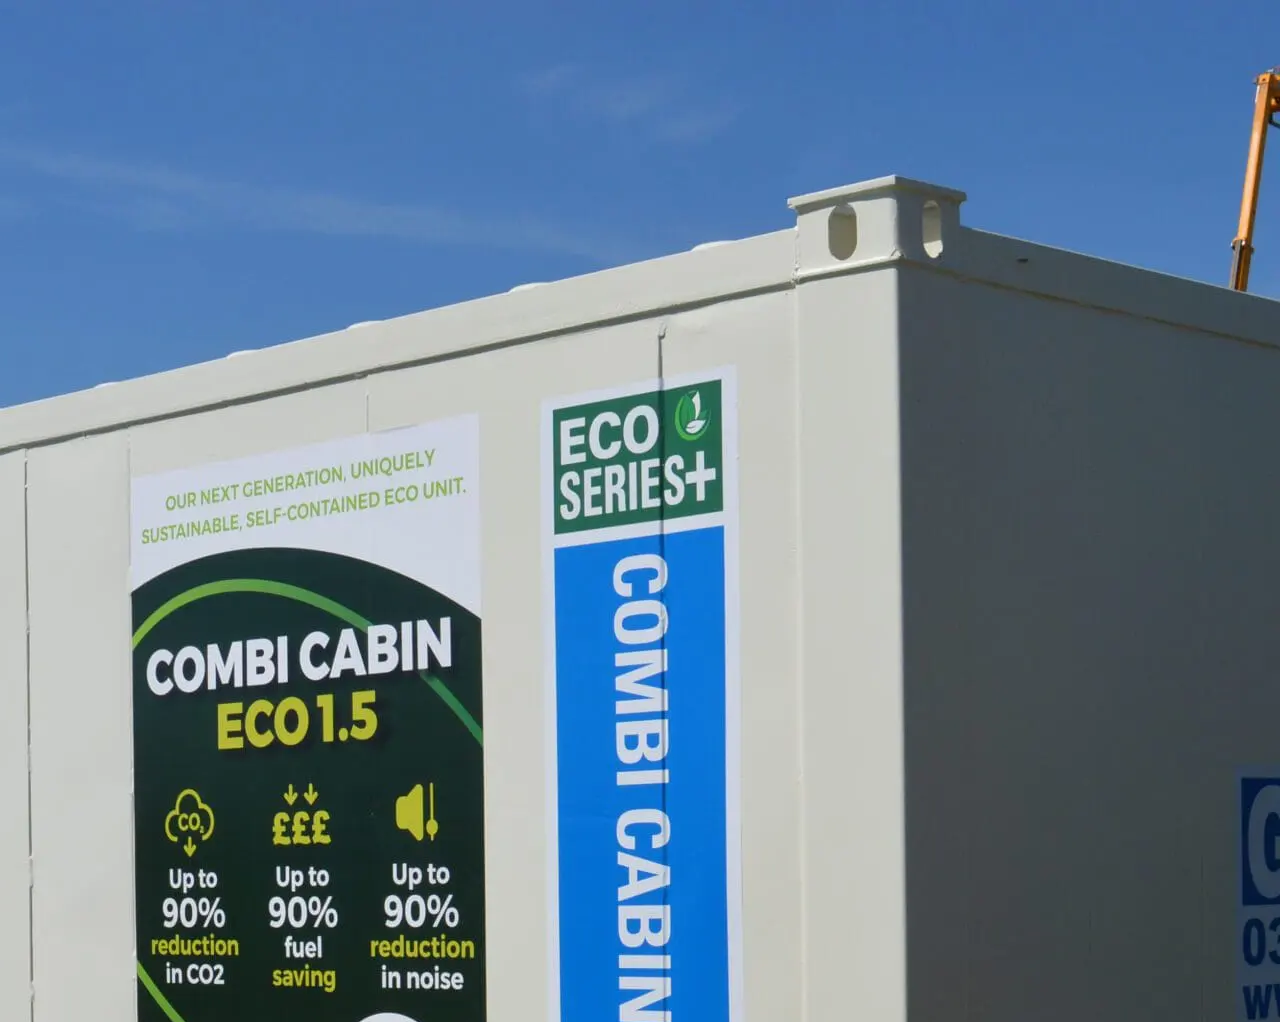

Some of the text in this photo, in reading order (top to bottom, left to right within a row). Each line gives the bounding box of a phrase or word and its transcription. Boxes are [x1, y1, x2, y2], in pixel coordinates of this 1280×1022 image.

[560, 405, 660, 466] ECO
[165, 448, 436, 511] OUR NEXT GENERATION, UNIQUELY
[560, 450, 716, 521] SERIES+
[141, 476, 467, 544] SUSTAINABLE, SELF-CONTAINED ECO UNIT.
[146, 616, 453, 697] COMBI CABIN
[612, 553, 669, 786] COMBI
[217, 690, 378, 750] ECO 1.5
[169, 869, 218, 892] Up to
[275, 866, 330, 891] Up to
[392, 863, 450, 888] Up to
[162, 897, 226, 928] 90%
[268, 896, 338, 929] 90%
[383, 895, 460, 928] 90%
[151, 935, 239, 956] reduction
[284, 935, 323, 958] fuel
[370, 936, 475, 959] reduction
[166, 962, 225, 985] in CO2
[272, 965, 336, 992] saving
[381, 966, 464, 990] in noise
